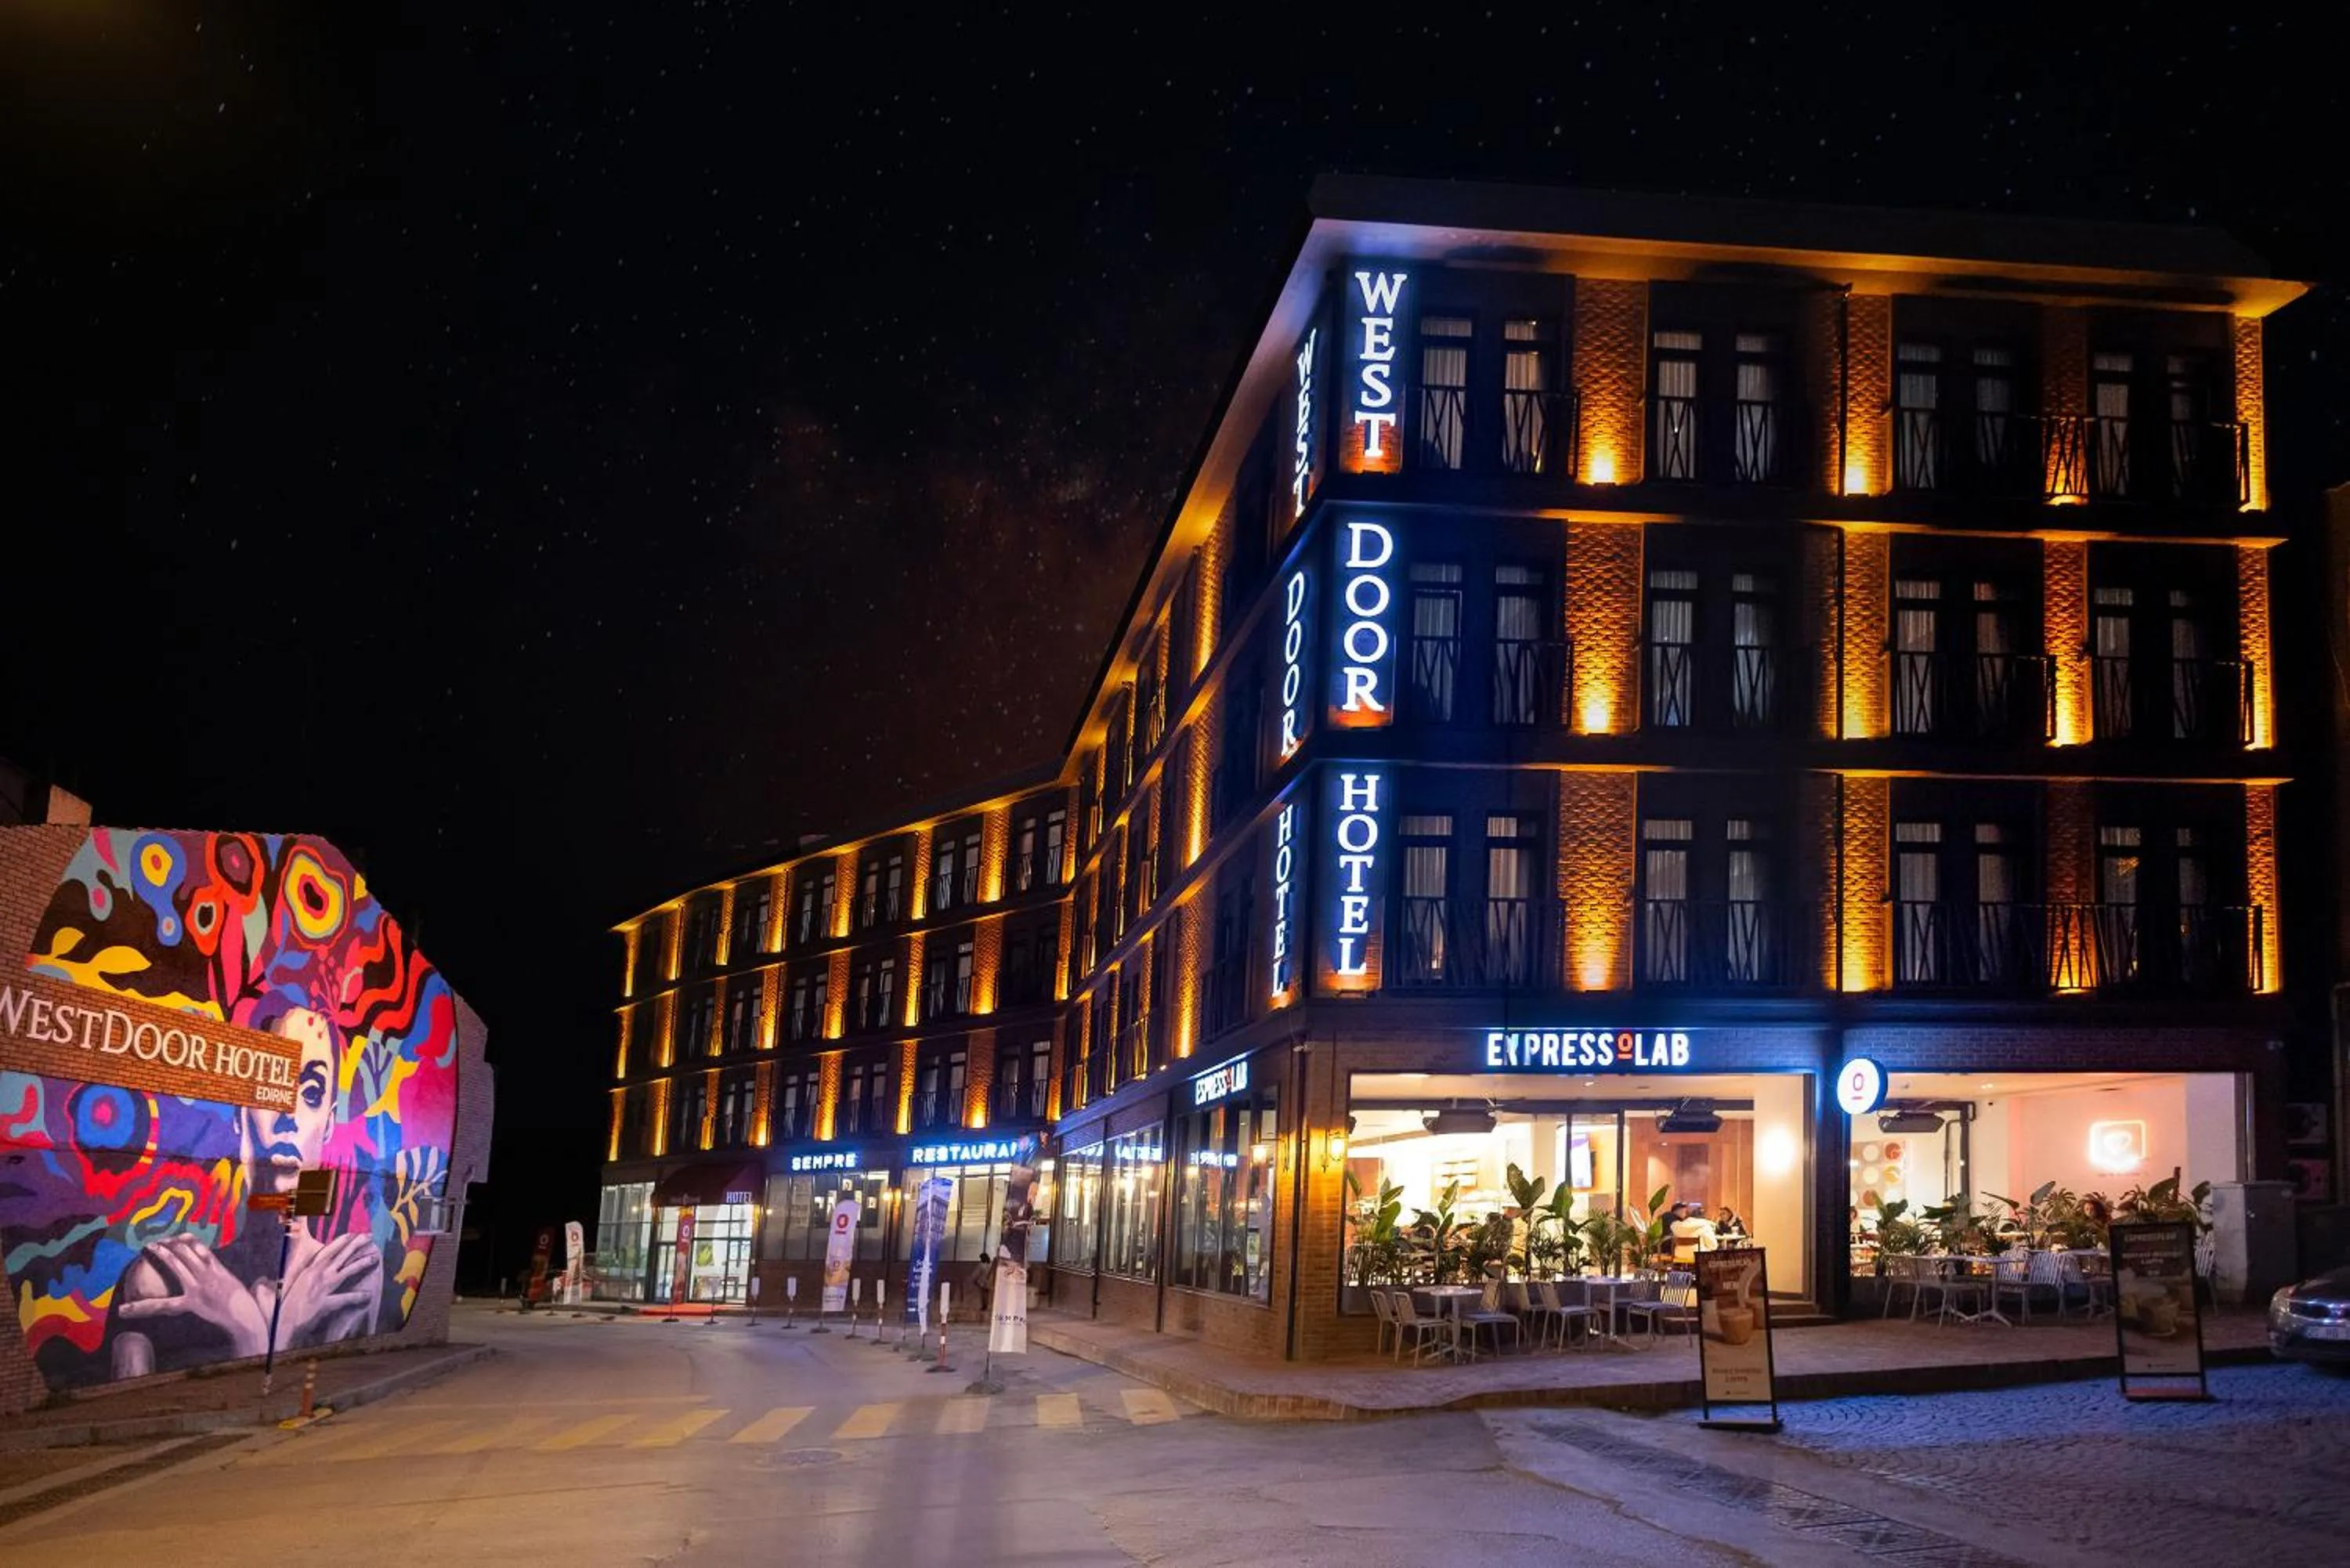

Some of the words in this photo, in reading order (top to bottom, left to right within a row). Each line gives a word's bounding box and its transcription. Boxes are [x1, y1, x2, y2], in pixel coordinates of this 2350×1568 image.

[1292, 327, 1317, 518] WEST
[1354, 271, 1408, 458] WEST
[1281, 570, 1305, 757] DOOR
[1341, 522, 1394, 712] DOOR
[1271, 804, 1293, 998] HOTEL
[1336, 773, 1381, 976] HOTEL
[0, 984, 208, 1074] WESTDOOR
[213, 1042, 295, 1088] HOTEL
[791, 1151, 856, 1171] SEMPRE
